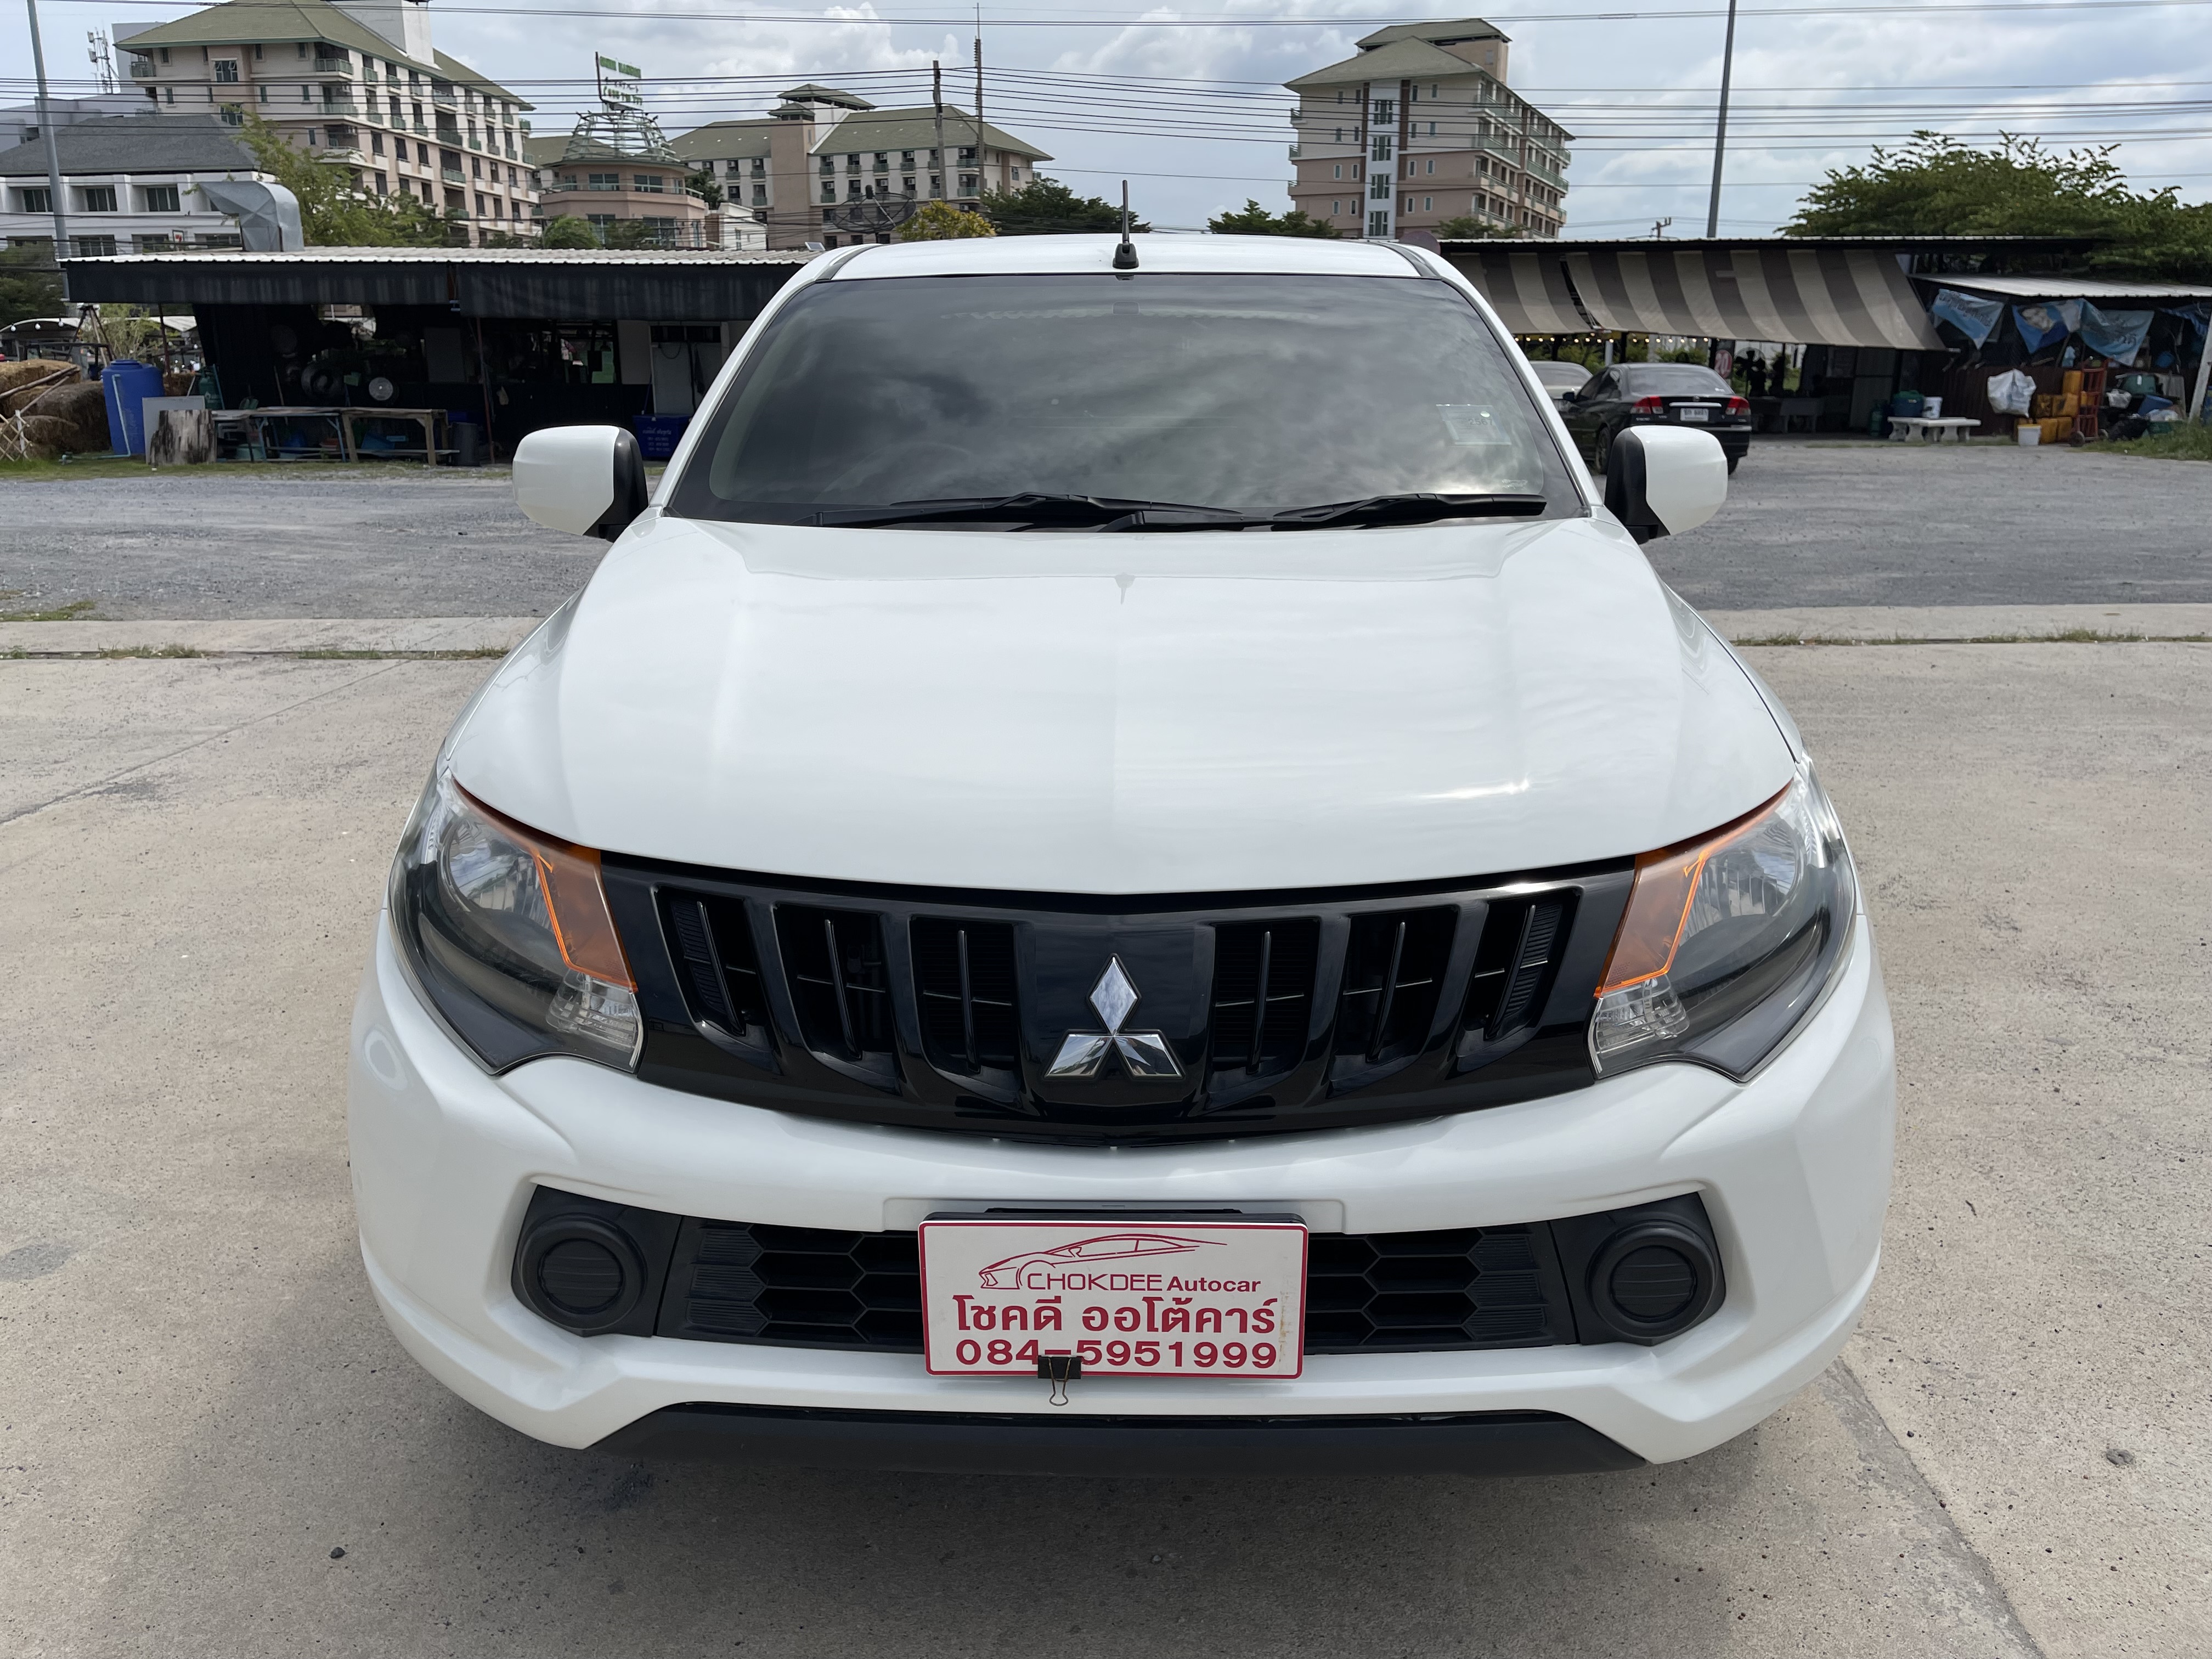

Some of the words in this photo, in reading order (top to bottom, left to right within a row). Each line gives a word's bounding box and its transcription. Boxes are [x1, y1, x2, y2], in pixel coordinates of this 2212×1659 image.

[1028, 1273, 1163, 1291] CHOKDEE
[1166, 1276, 1261, 1292] Autocar
[952, 1295, 1062, 1330] โชคดี
[1082, 1296, 1277, 1334] ออโต้คาร์
[956, 1339, 1276, 1369] 084-5951999
